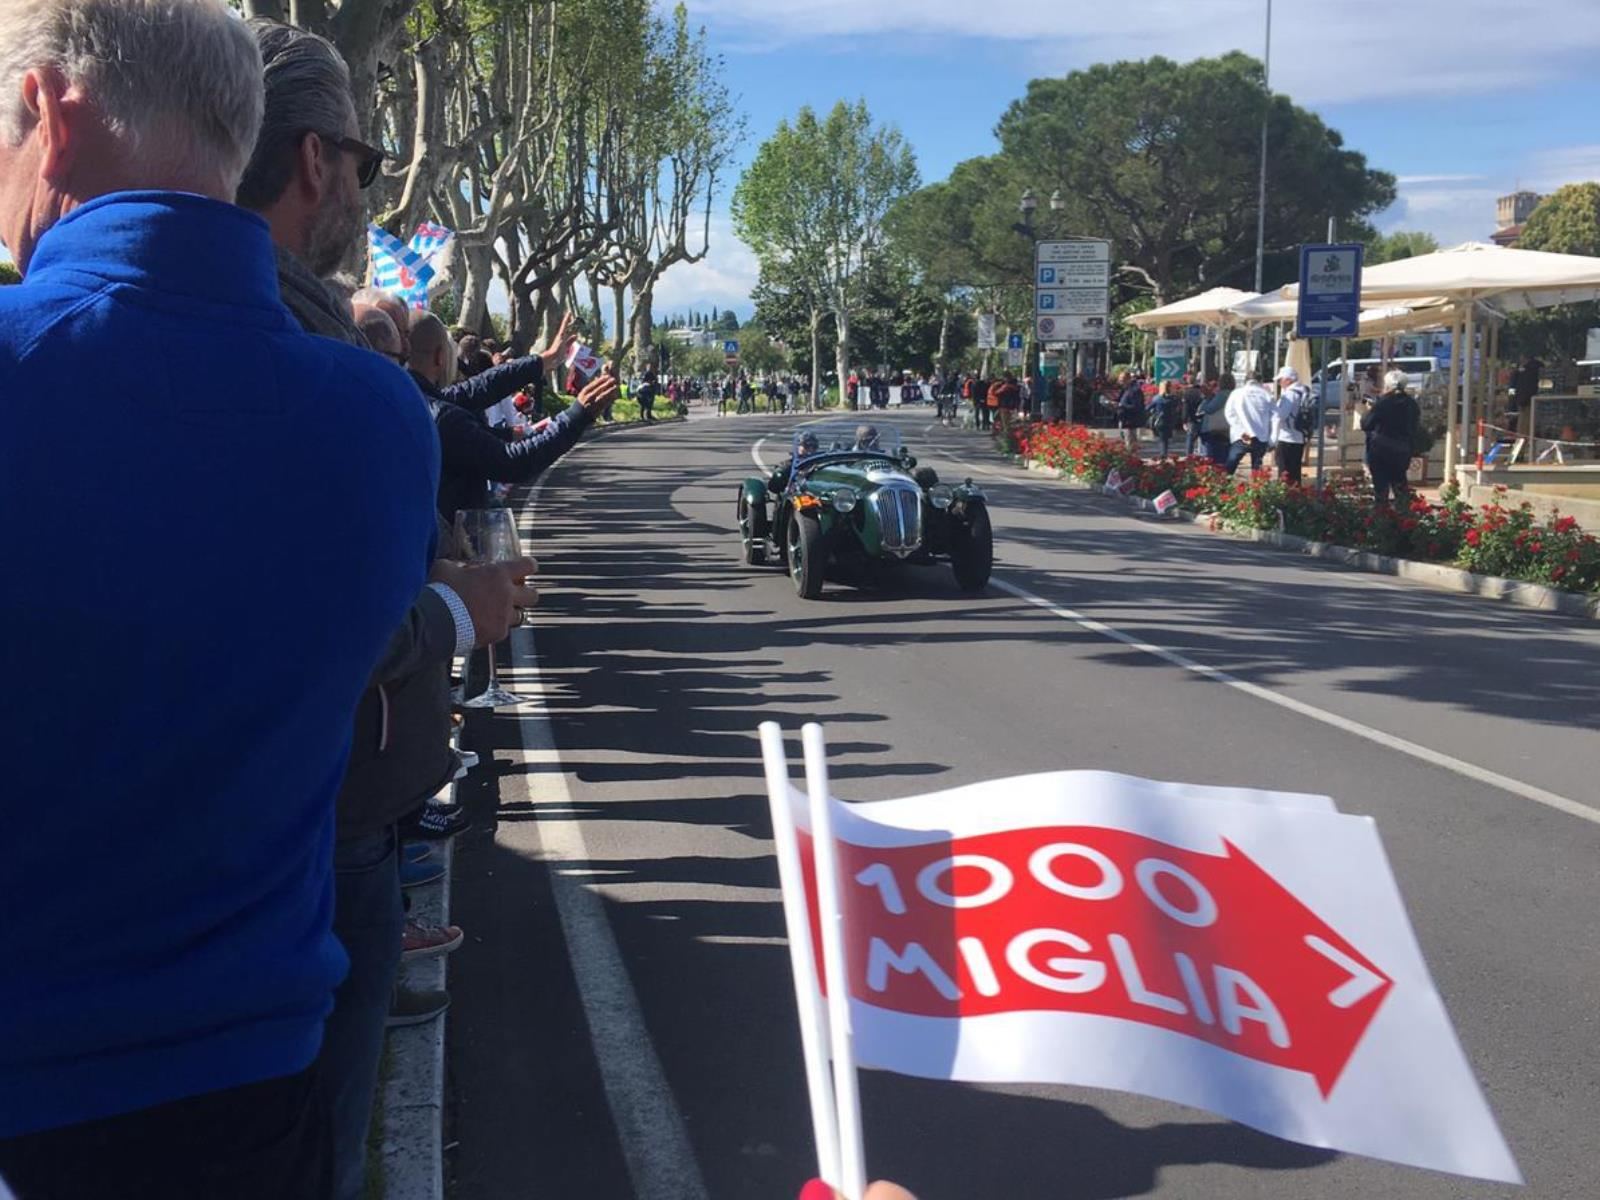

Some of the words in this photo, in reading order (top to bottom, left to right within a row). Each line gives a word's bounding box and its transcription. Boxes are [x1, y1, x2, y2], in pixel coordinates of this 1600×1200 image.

[1043, 270, 1052, 282] P
[1043, 297, 1052, 308] P
[855, 842, 1219, 928] 1000
[866, 928, 1292, 1049] MIGLIA
